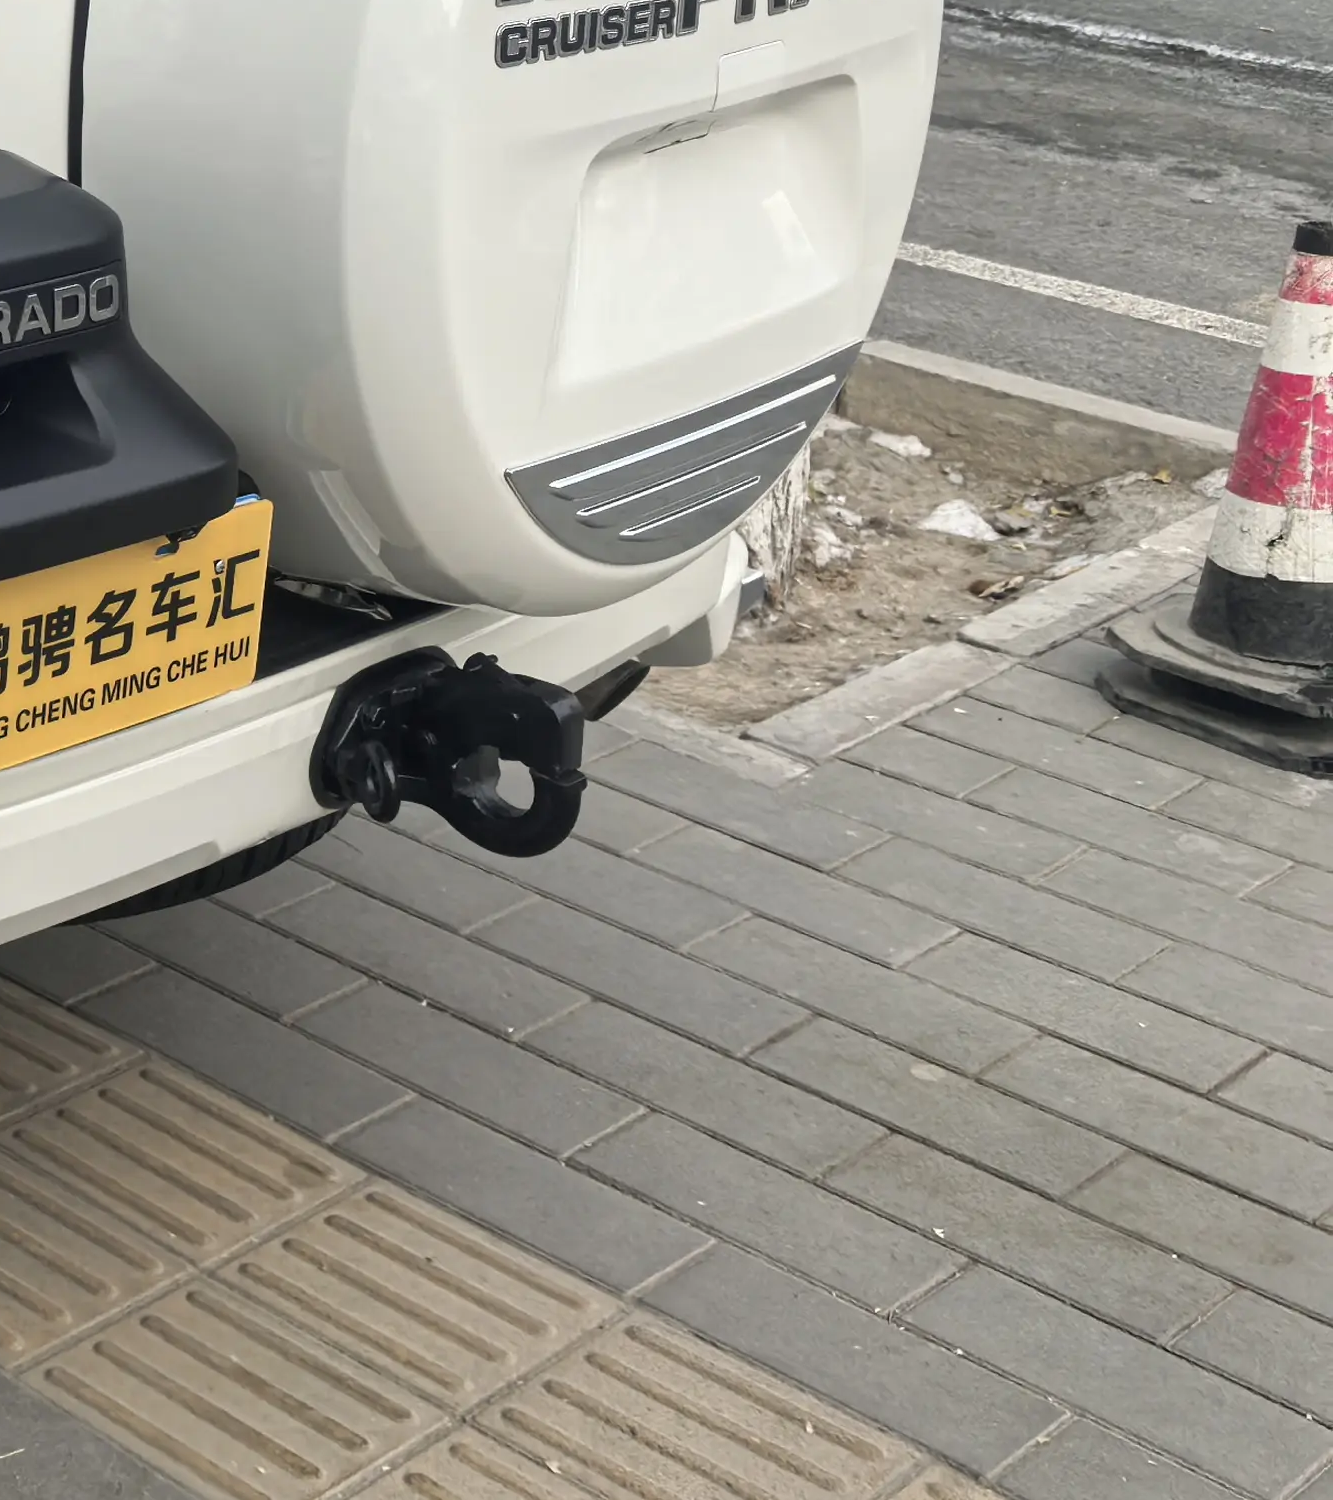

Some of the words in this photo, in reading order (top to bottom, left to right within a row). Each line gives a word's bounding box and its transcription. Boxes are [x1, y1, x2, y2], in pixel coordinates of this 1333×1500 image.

[15, 688, 96, 732] CHENG
[101, 667, 161, 705] MING
[167, 649, 208, 684] CHE
[214, 636, 250, 668] HUI
